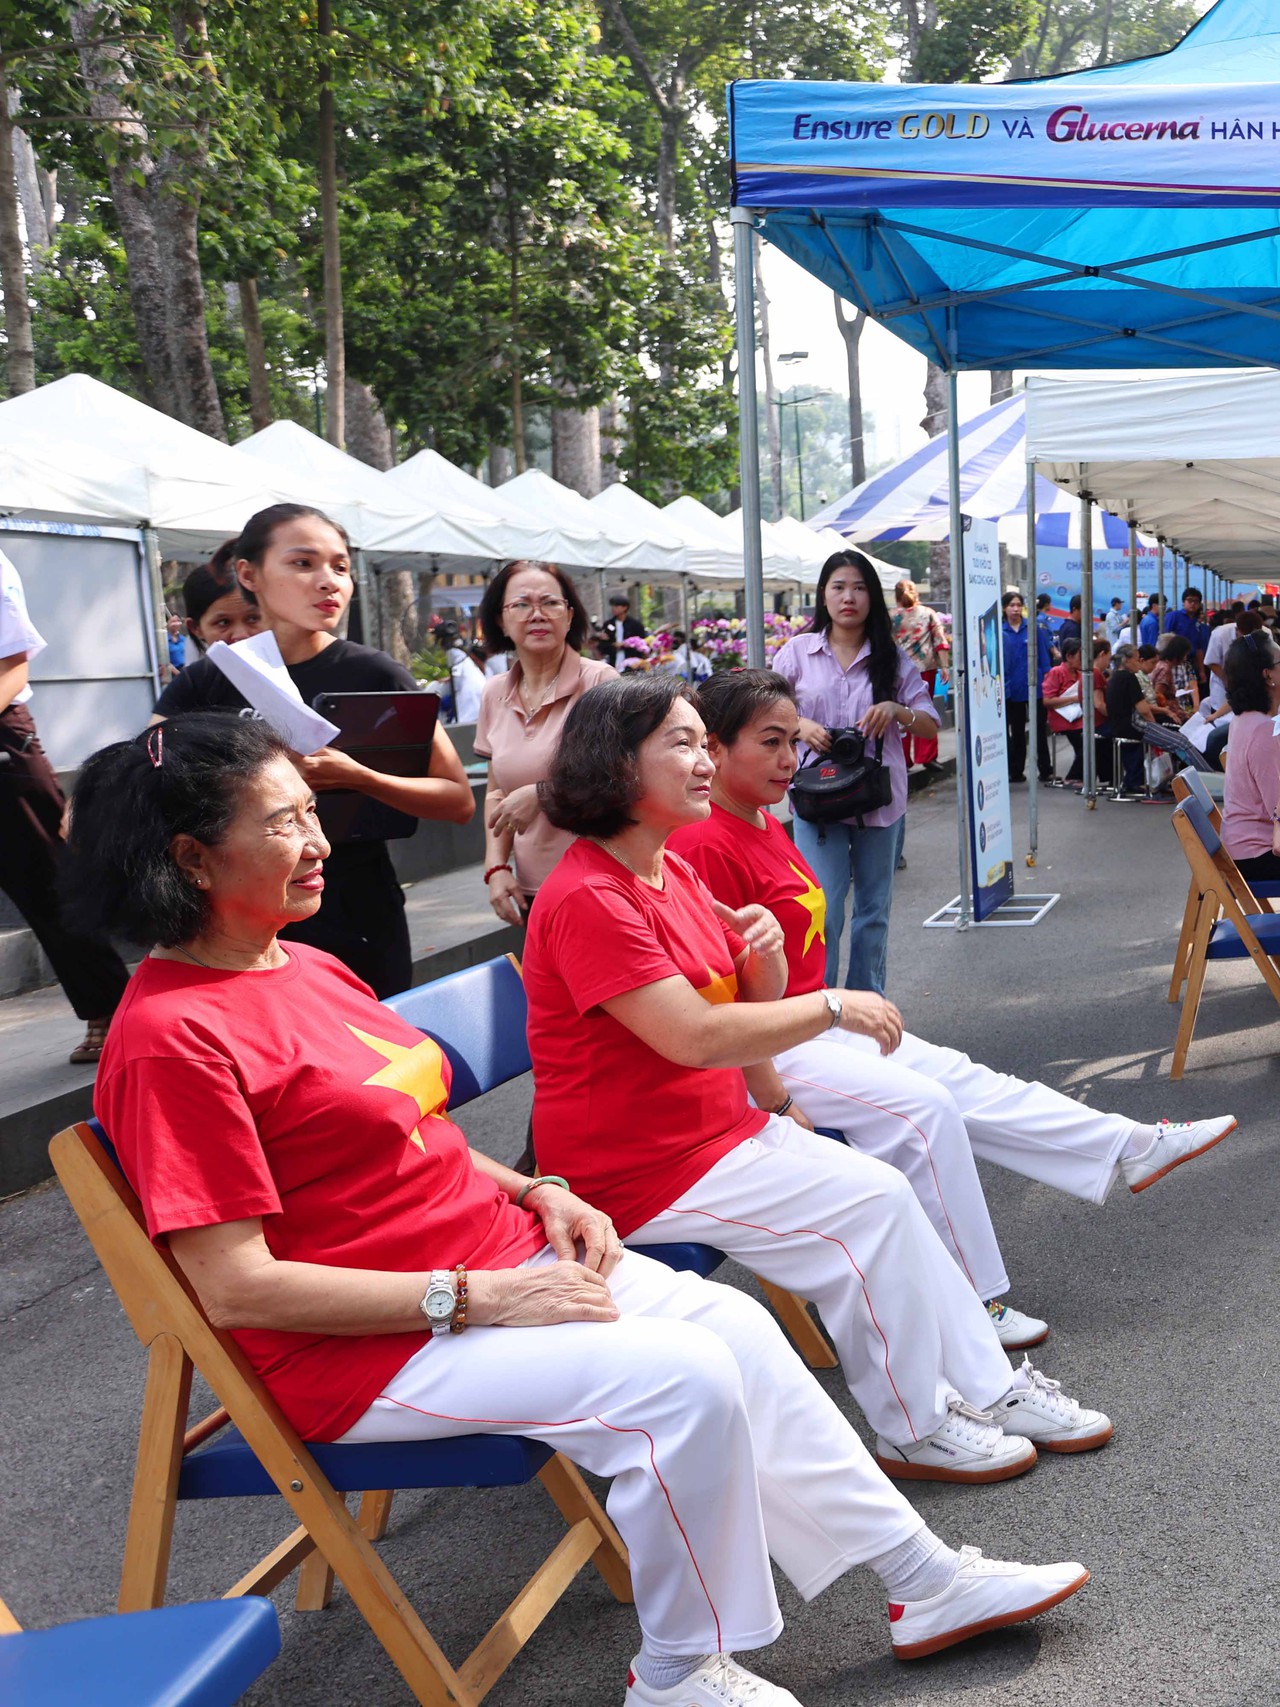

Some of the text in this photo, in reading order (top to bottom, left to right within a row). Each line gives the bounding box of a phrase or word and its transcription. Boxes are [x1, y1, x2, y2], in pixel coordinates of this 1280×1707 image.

[793, 113, 892, 140] Ensure
[896, 113, 990, 140] GOLD
[1002, 117, 1034, 139] VÀ
[1046, 105, 1201, 142] Glucerna
[1211, 118, 1263, 139] HÂN
